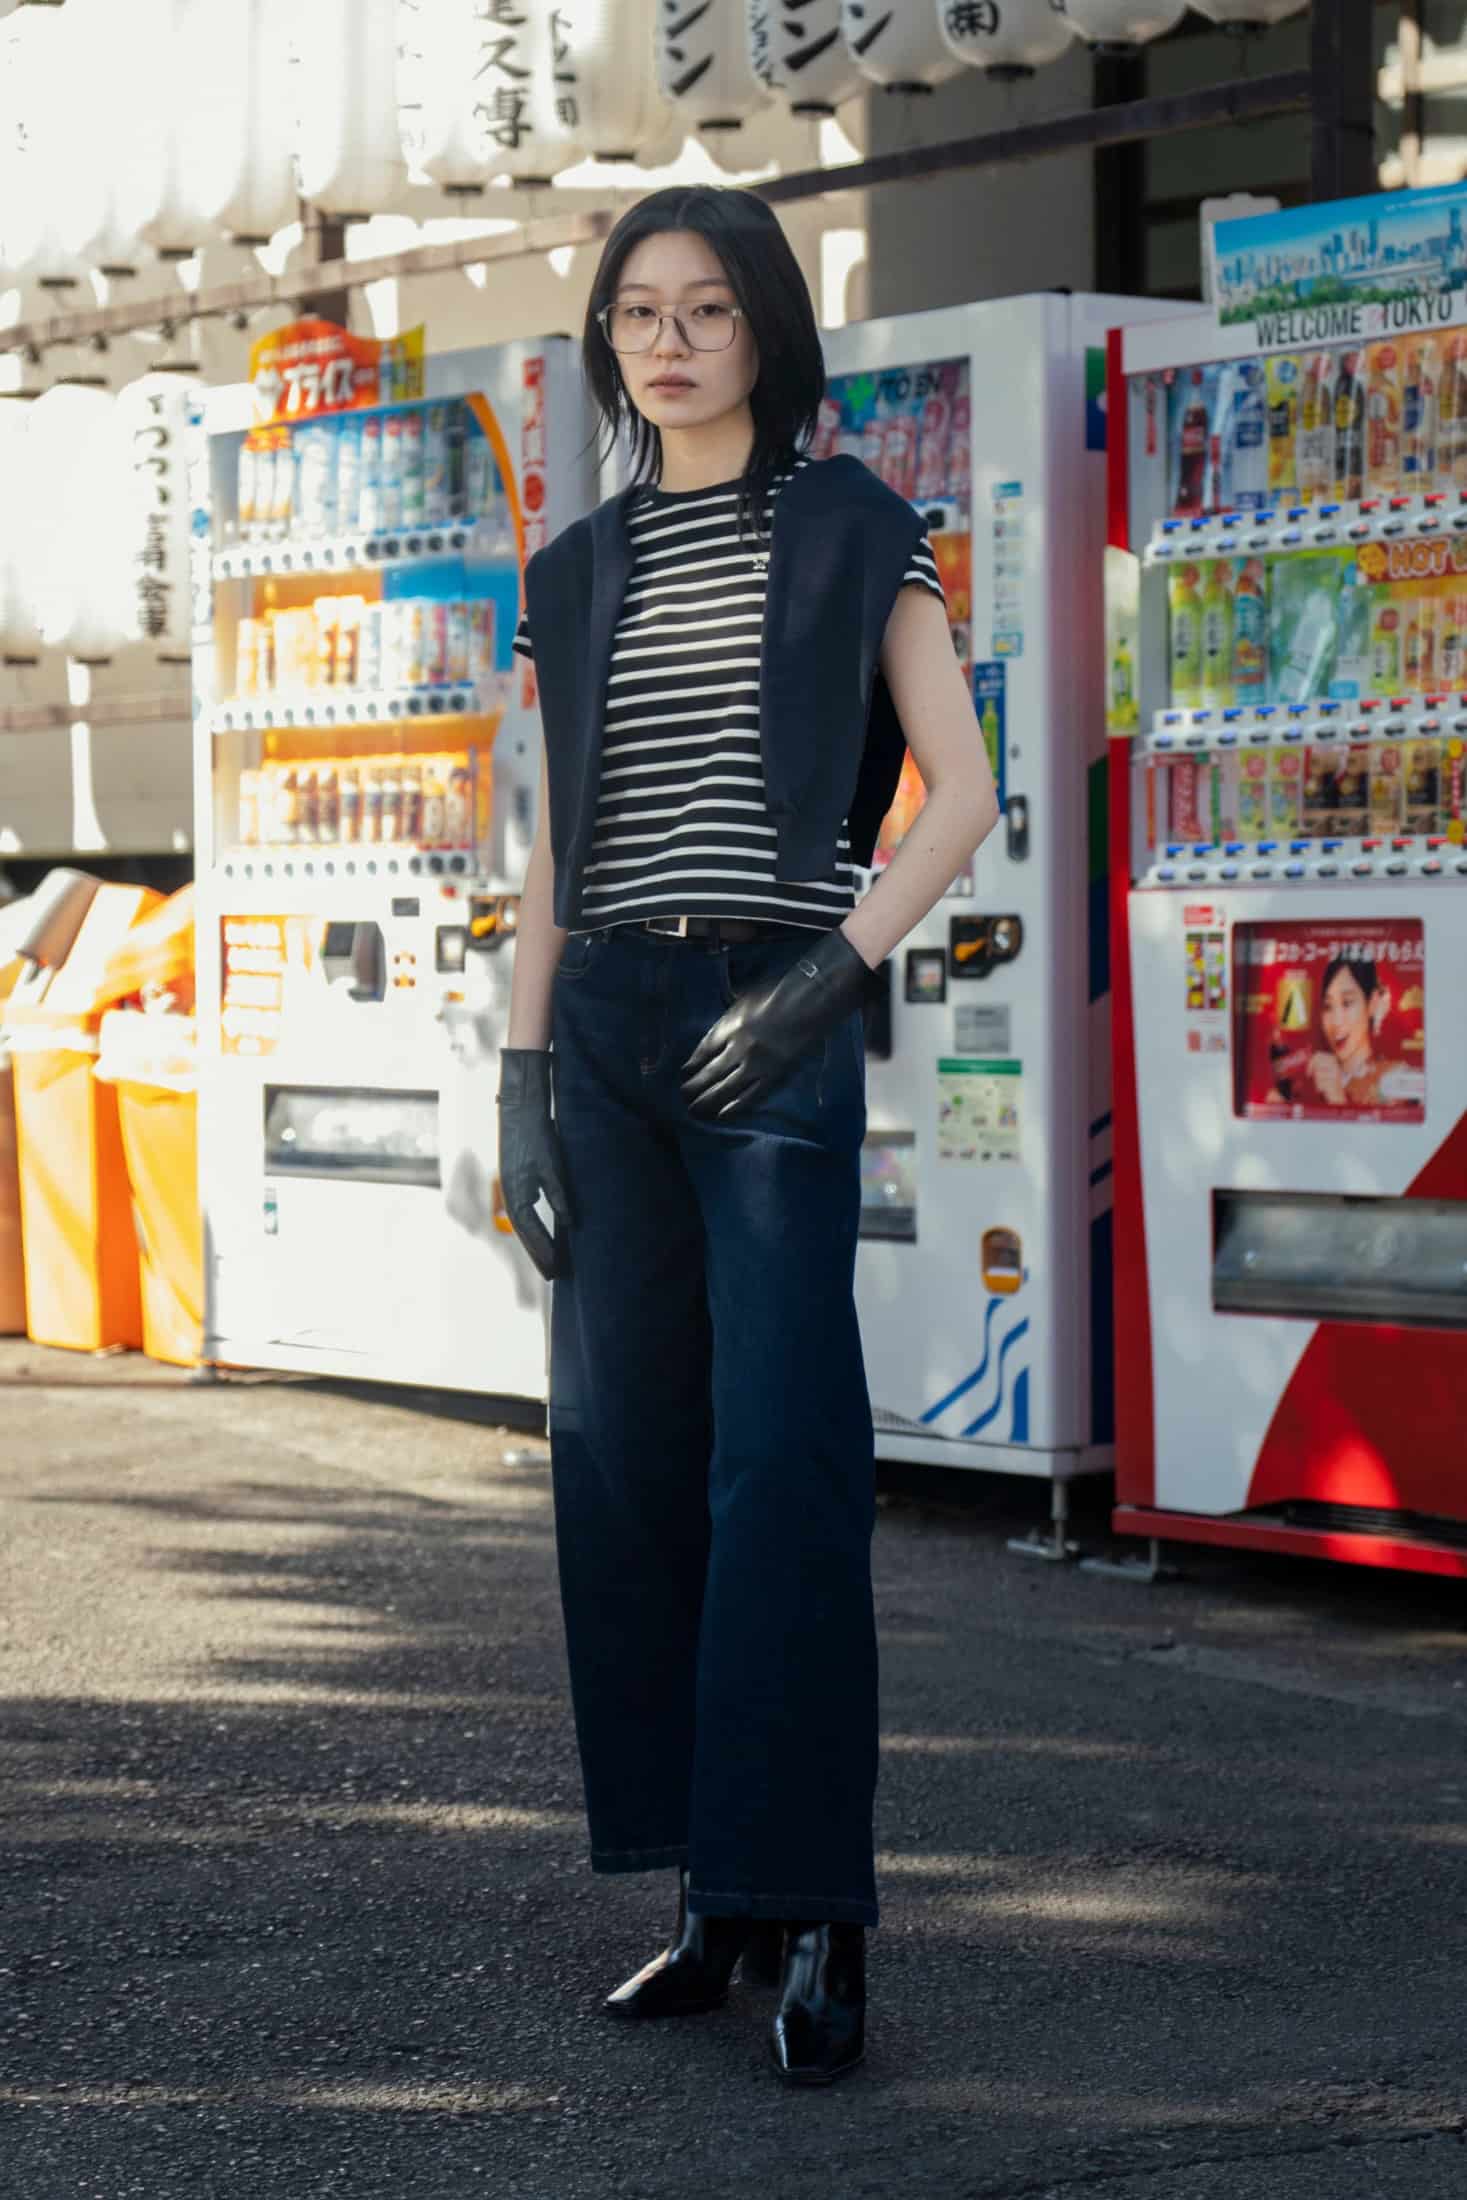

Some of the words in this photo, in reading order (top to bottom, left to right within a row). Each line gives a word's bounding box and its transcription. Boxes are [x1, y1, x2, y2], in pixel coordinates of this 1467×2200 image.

[1256, 303, 1362, 348] WELCOME
[1381, 293, 1452, 330] TOKYO
[1390, 542, 1447, 577] HOT
